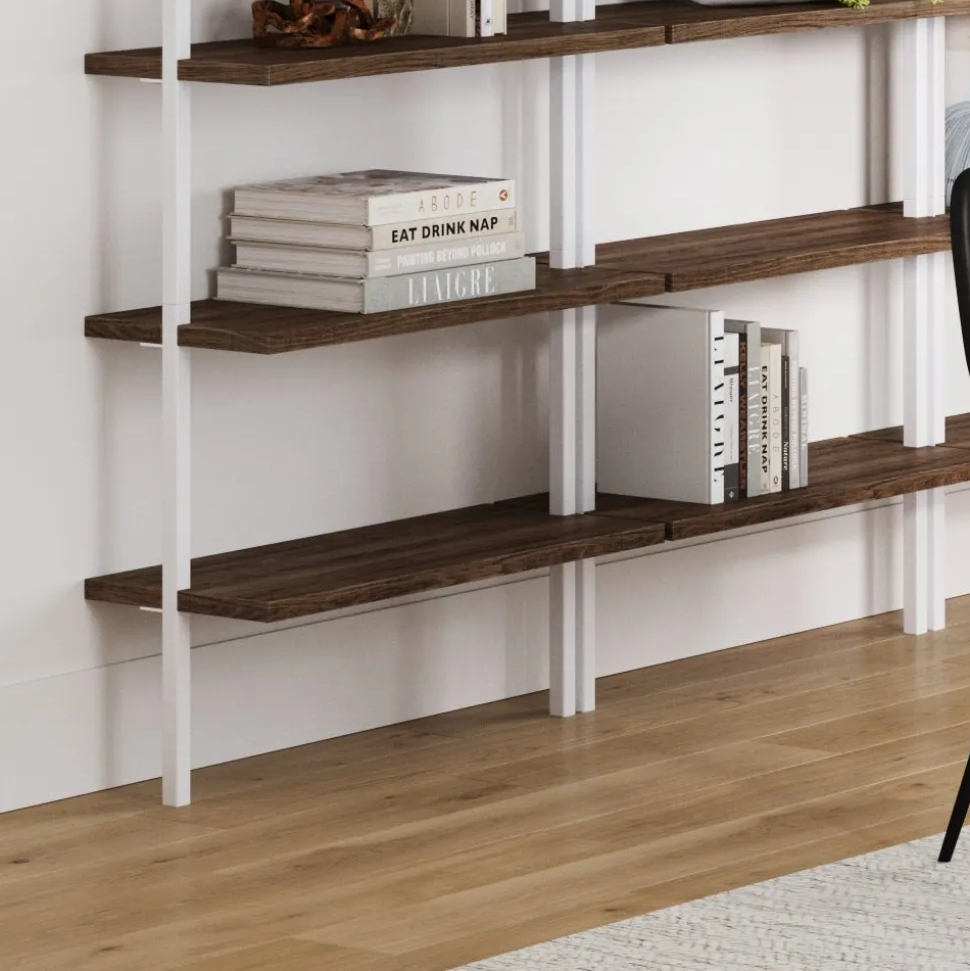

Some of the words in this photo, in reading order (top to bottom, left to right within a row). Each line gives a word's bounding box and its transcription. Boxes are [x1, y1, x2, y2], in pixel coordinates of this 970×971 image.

[418, 191, 477, 212] ABODE
[392, 227, 417, 243] EAT
[422, 221, 466, 239] DRINK
[470, 216, 499, 232] NAP
[471, 242, 507, 258] POLLOCK
[408, 266, 495, 305] LIAIGRE
[747, 367, 760, 455] LIAIGRE
